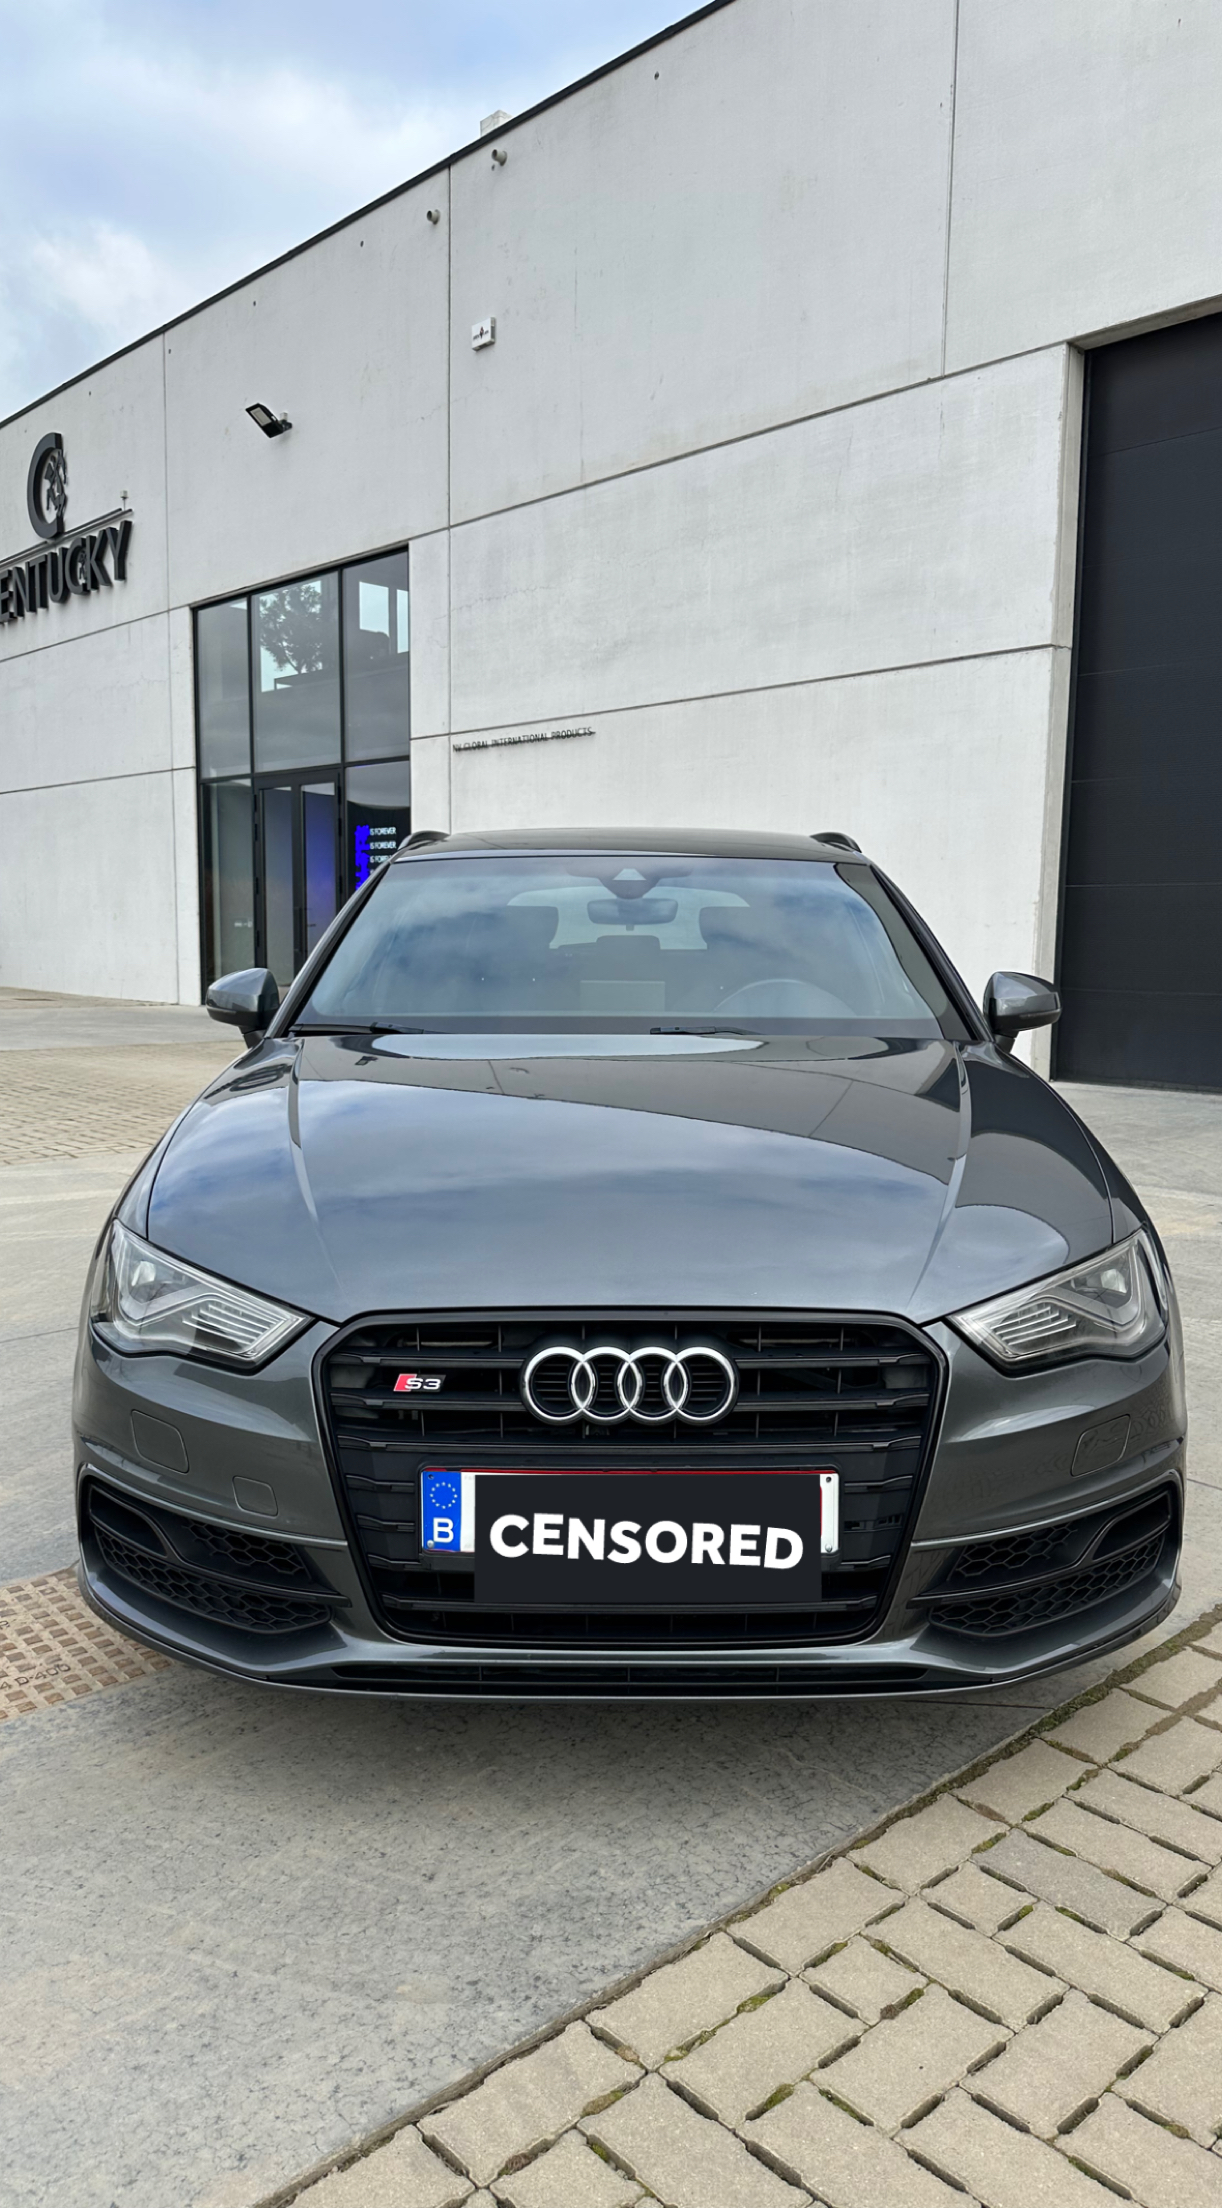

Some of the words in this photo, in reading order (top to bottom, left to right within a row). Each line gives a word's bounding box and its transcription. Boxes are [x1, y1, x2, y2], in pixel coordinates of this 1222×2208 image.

[463, 740, 488, 750] GLOBAL
[491, 732, 548, 747] INTERNATIONAL
[551, 726, 592, 739] PRODUCTS
[404, 1378, 441, 1390] S3
[433, 1517, 454, 1543] B
[14, 1663, 71, 1686] D-400
